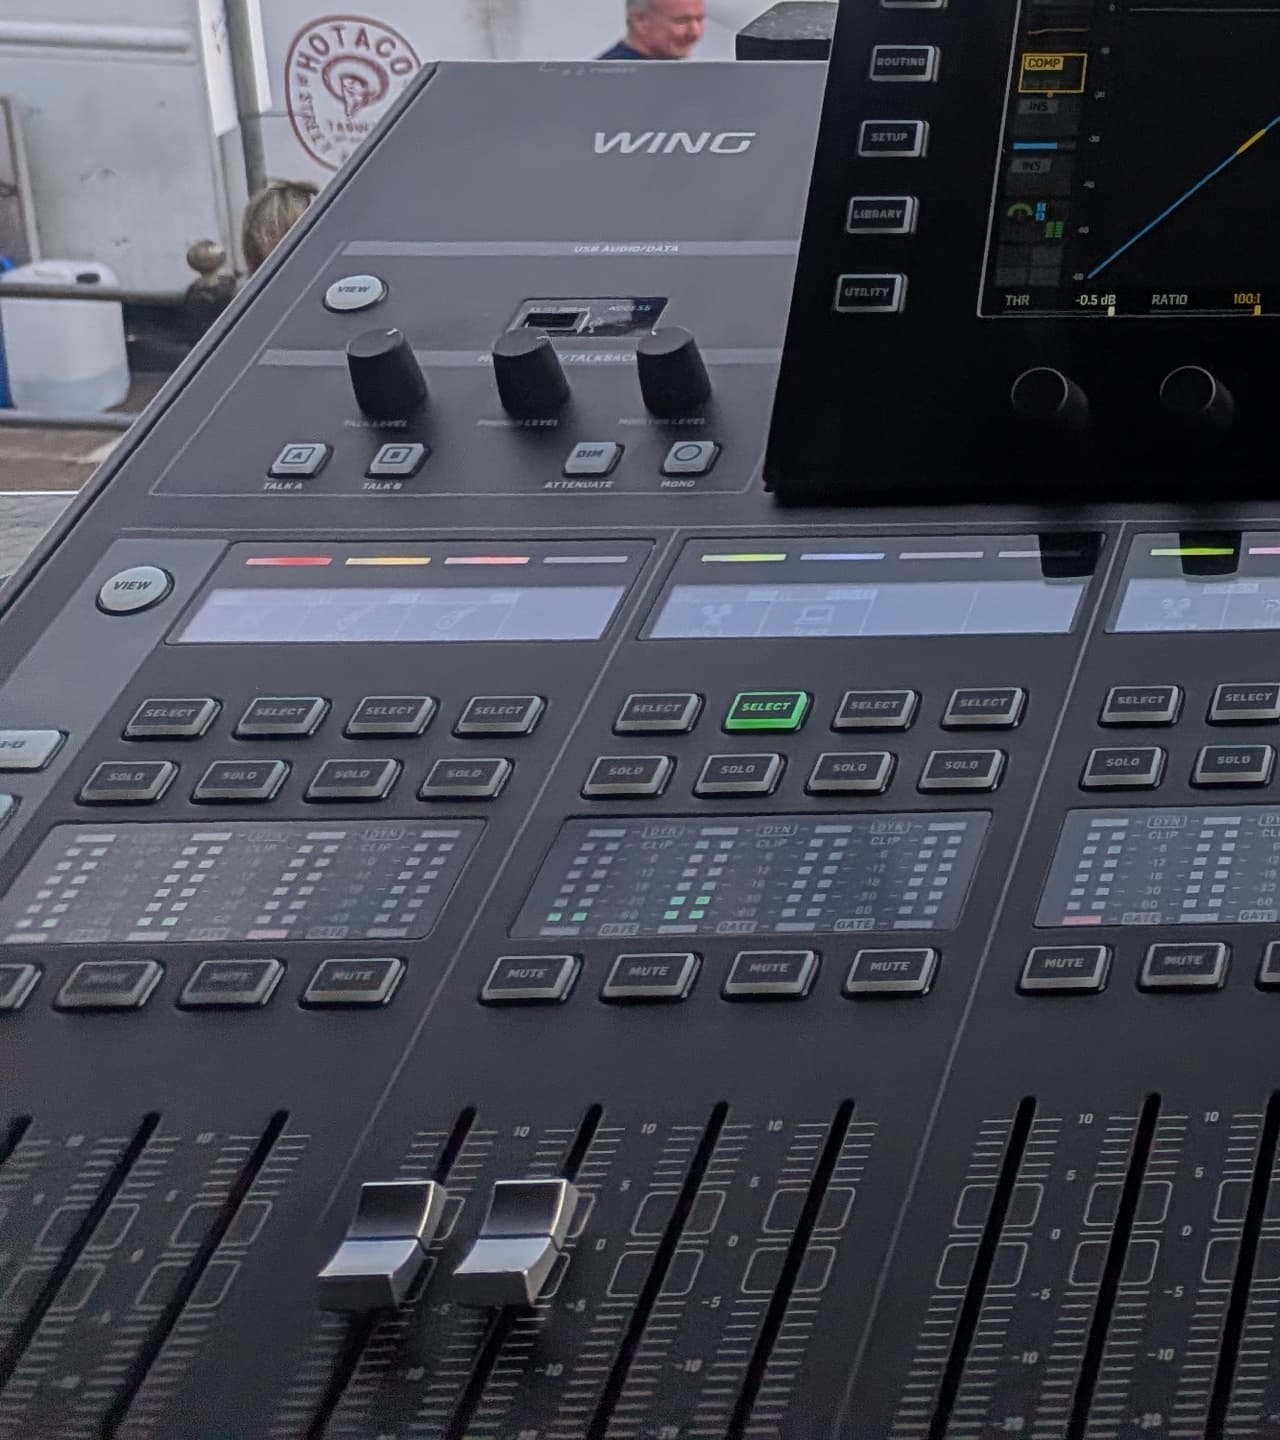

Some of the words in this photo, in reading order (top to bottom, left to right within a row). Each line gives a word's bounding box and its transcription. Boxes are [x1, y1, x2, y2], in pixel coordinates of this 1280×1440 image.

[1028, 57, 1062, 69] COMP
[594, 130, 755, 154] WING
[870, 132, 909, 142] SETUP
[854, 209, 903, 220] LIBRARY
[337, 284, 371, 295] VIEW
[844, 287, 890, 298] UTILITY
[1005, 295, 1030, 306] THR
[1074, 294, 1099, 306] -0.5
[1100, 294, 1116, 306] dB
[1152, 294, 1188, 306] RATIO
[1232, 293, 1262, 305] 100:1
[544, 480, 615, 489] ATTENUATE
[660, 480, 695, 488] MONO
[741, 701, 791, 713] SELECT
